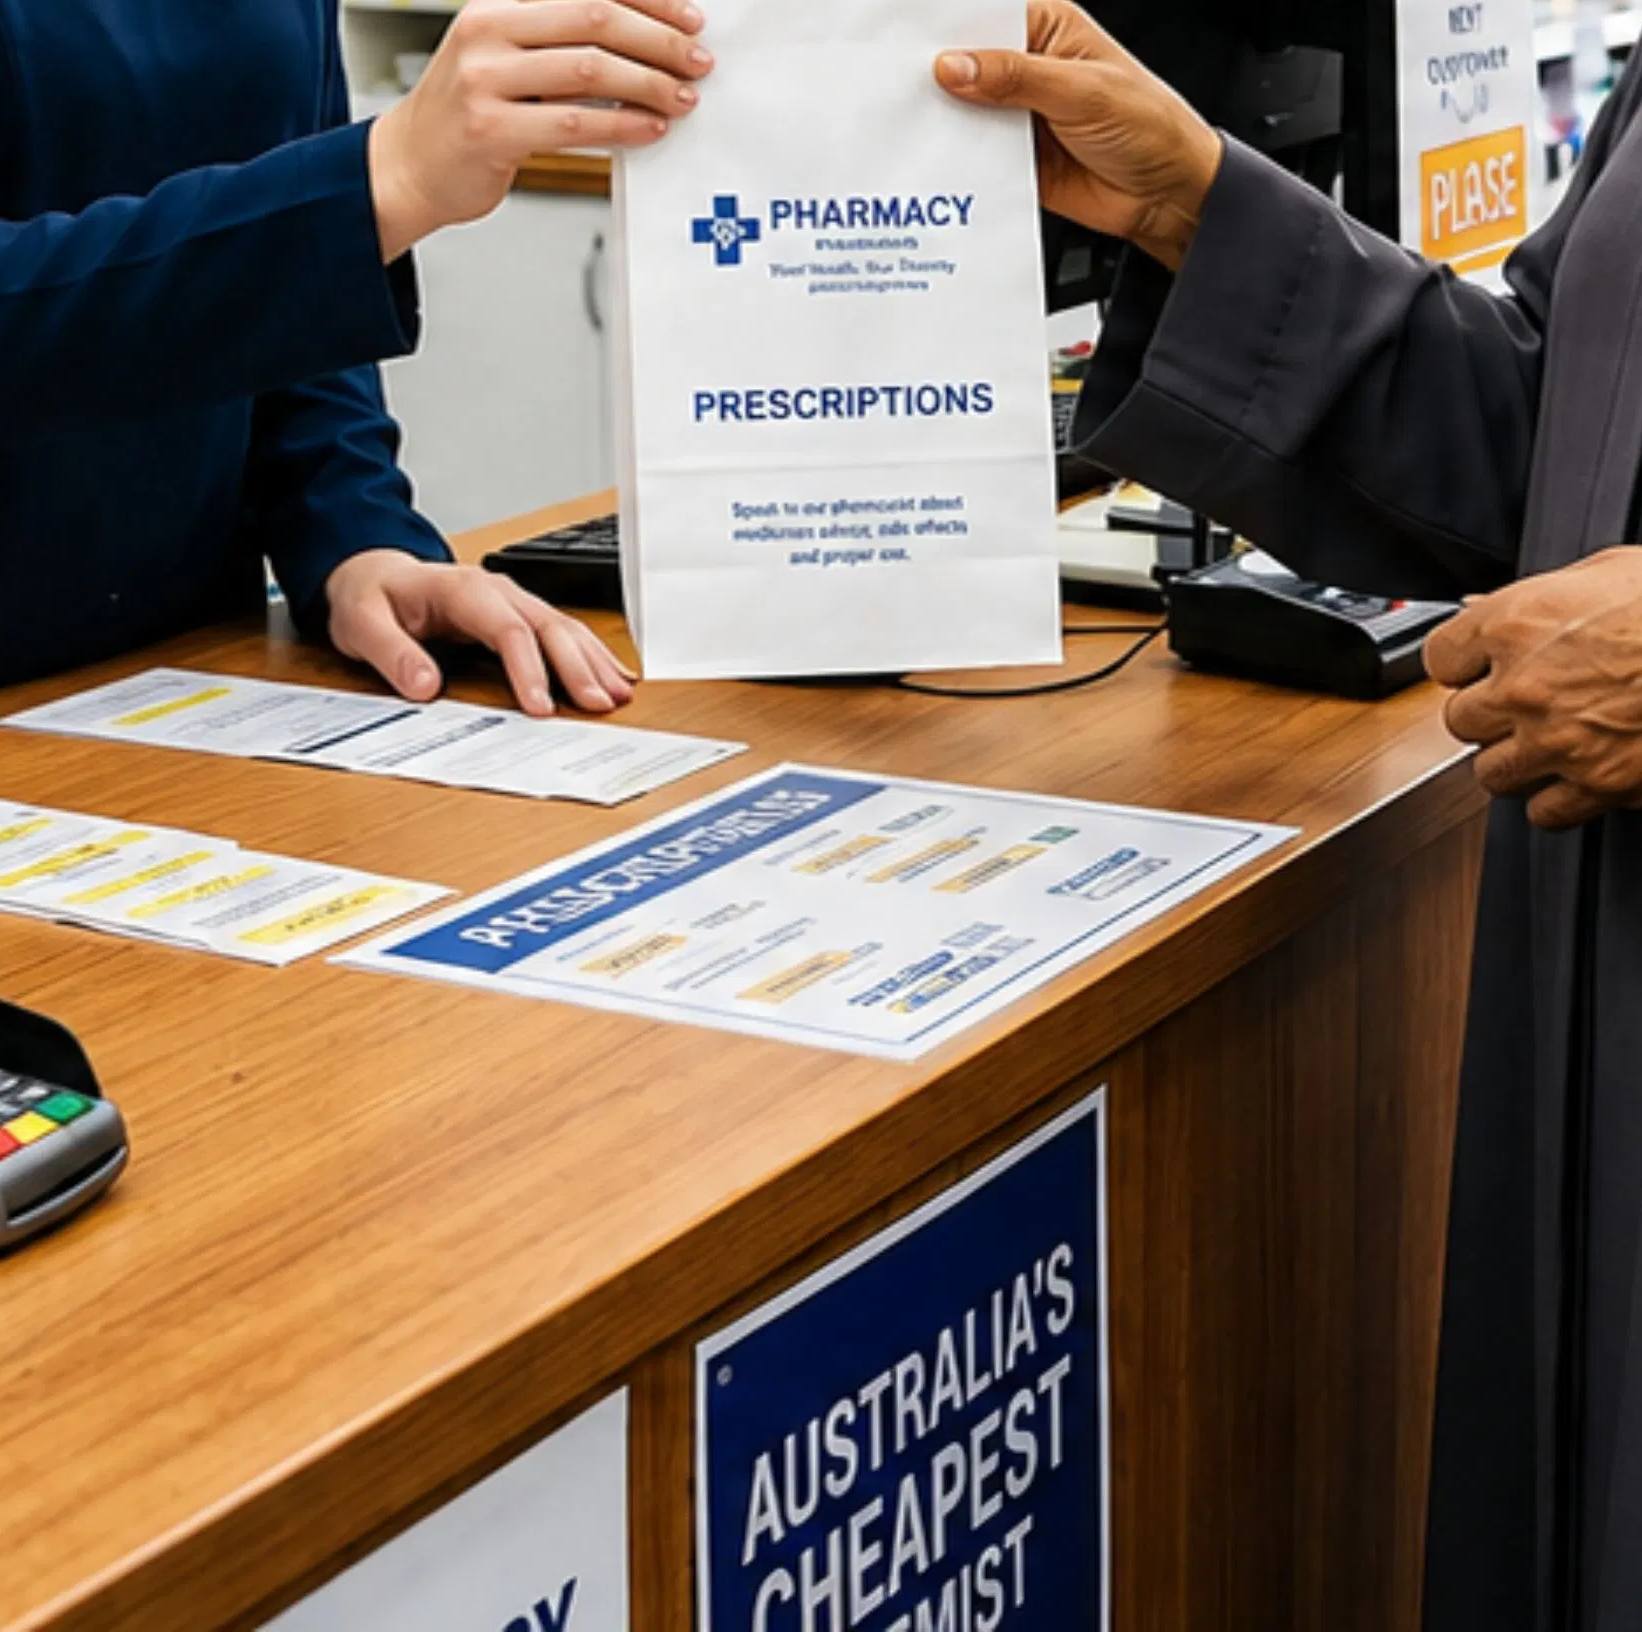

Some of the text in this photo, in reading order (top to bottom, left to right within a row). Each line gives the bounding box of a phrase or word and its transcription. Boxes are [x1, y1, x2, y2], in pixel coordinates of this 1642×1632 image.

[769, 194, 975, 230] PHARMACY
[693, 382, 995, 423] PRESCRIPTIONS
[742, 1242, 1076, 1566] AUSTRALIA'S
[753, 1355, 1071, 1632] CHEAPEST
